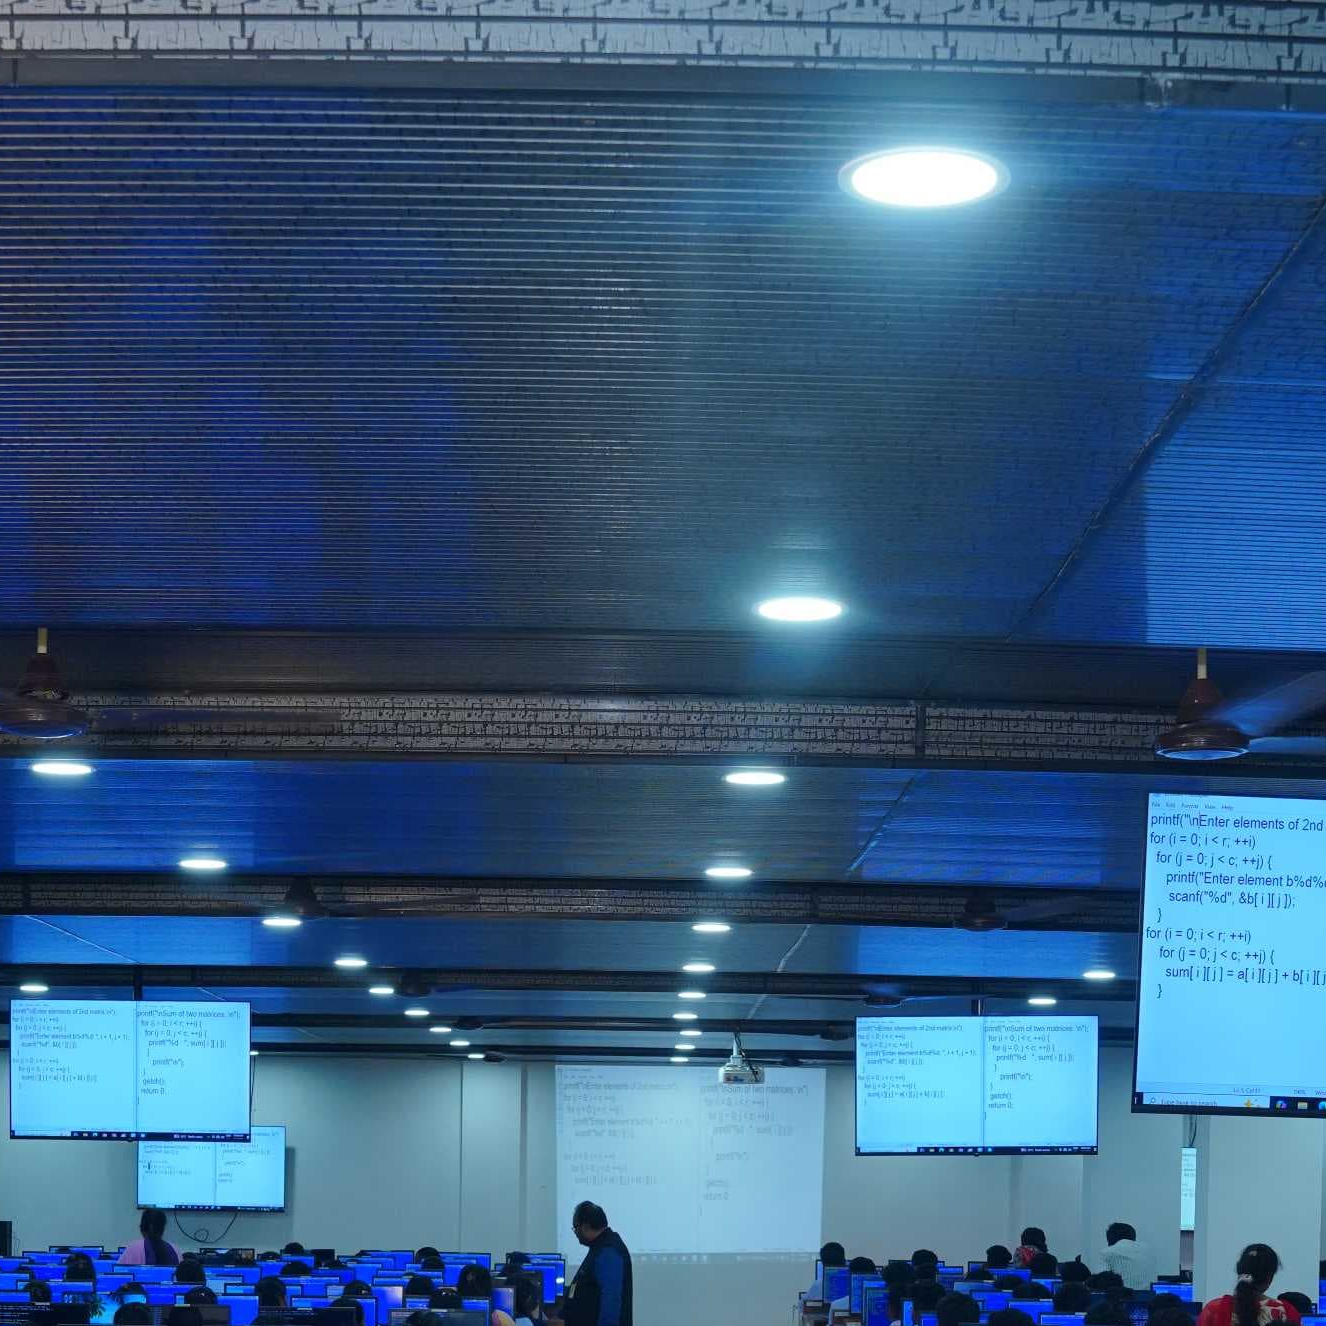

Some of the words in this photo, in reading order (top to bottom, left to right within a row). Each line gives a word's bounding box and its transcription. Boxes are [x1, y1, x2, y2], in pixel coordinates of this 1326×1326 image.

[1233, 819, 1284, 830] elements
[1288, 819, 1300, 830] of
[1302, 819, 1323, 831] 2nd
[1150, 831, 1165, 845] for
[1234, 835, 1255, 850] ++i)
[1156, 850, 1172, 863] for
[1242, 854, 1263, 870] ++j)
[1238, 875, 1283, 886] element
[1238, 891, 1258, 907] &b[
